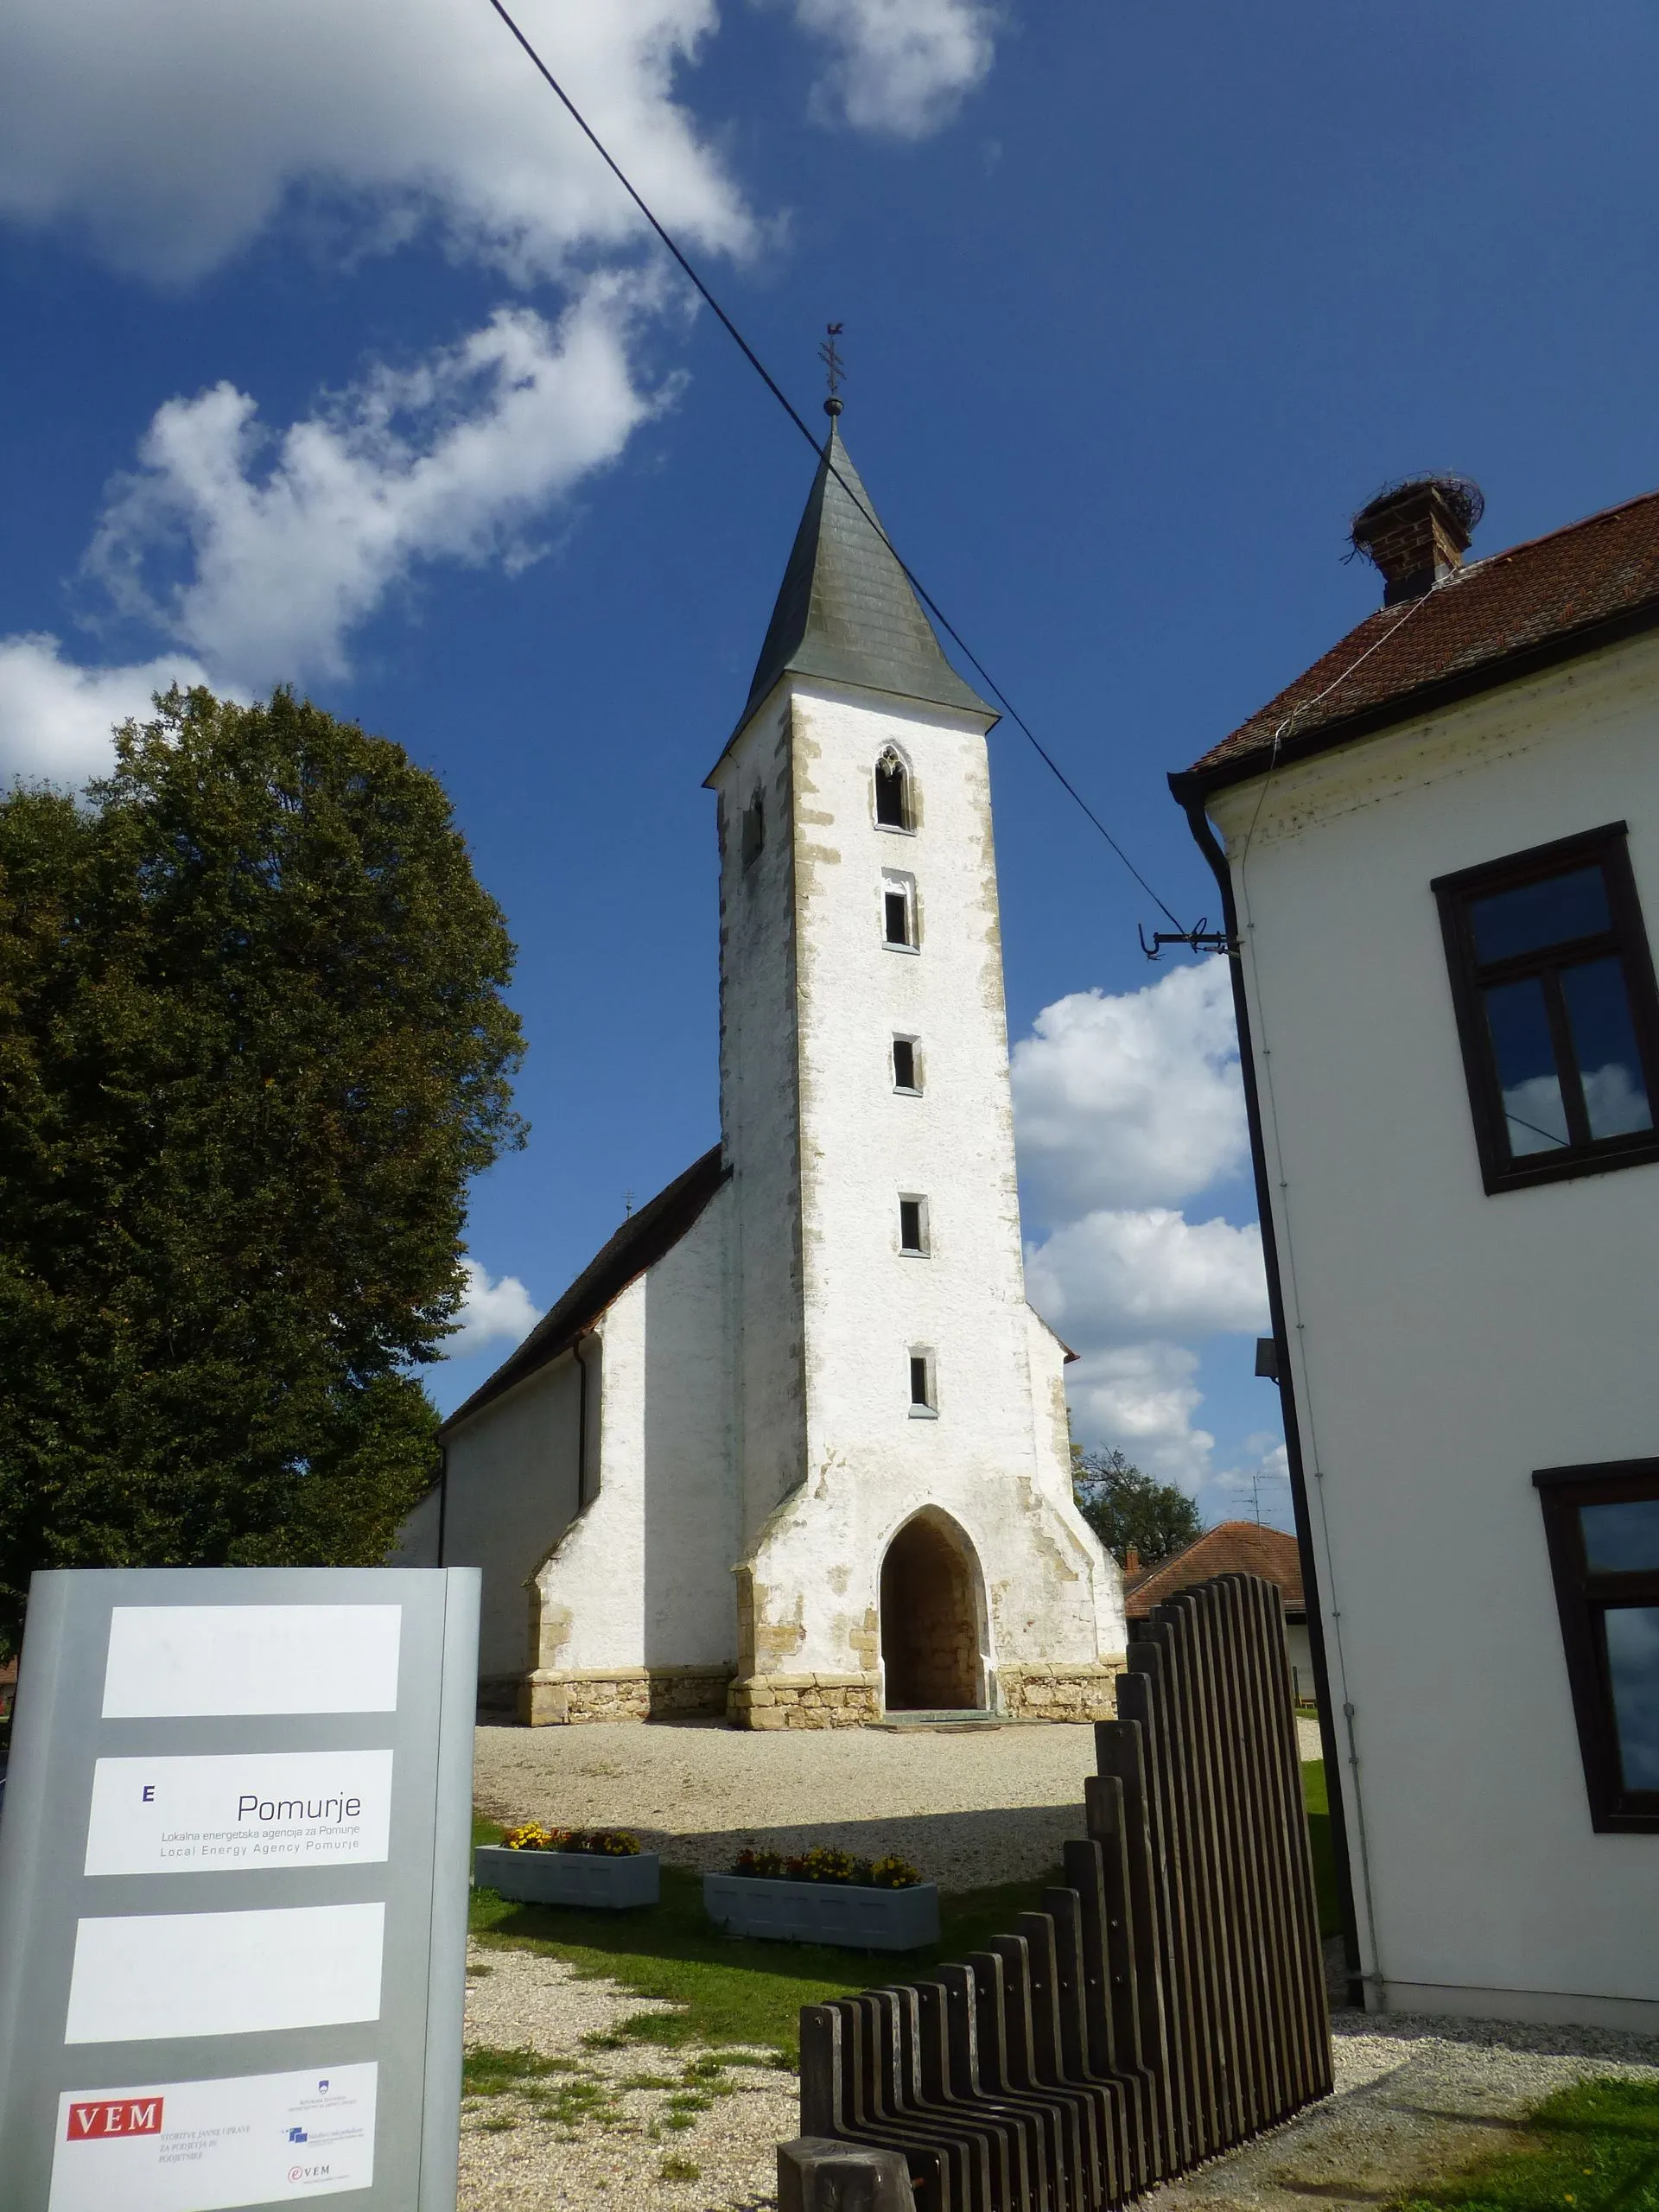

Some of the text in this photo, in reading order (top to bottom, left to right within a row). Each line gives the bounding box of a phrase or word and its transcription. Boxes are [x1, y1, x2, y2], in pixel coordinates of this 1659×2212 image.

[142, 1785, 156, 1802] E
[238, 1791, 361, 1824] Pomurje
[162, 1831, 200, 1842] Lokalna
[202, 1829, 259, 1842] energetska
[262, 1828, 302, 1840] agencija
[319, 1826, 360, 1837] Pomurje
[161, 1840, 359, 1858] Local Energy Agency Pomurje
[75, 2103, 157, 2134] VEM
[304, 2164, 330, 2177] VEM
